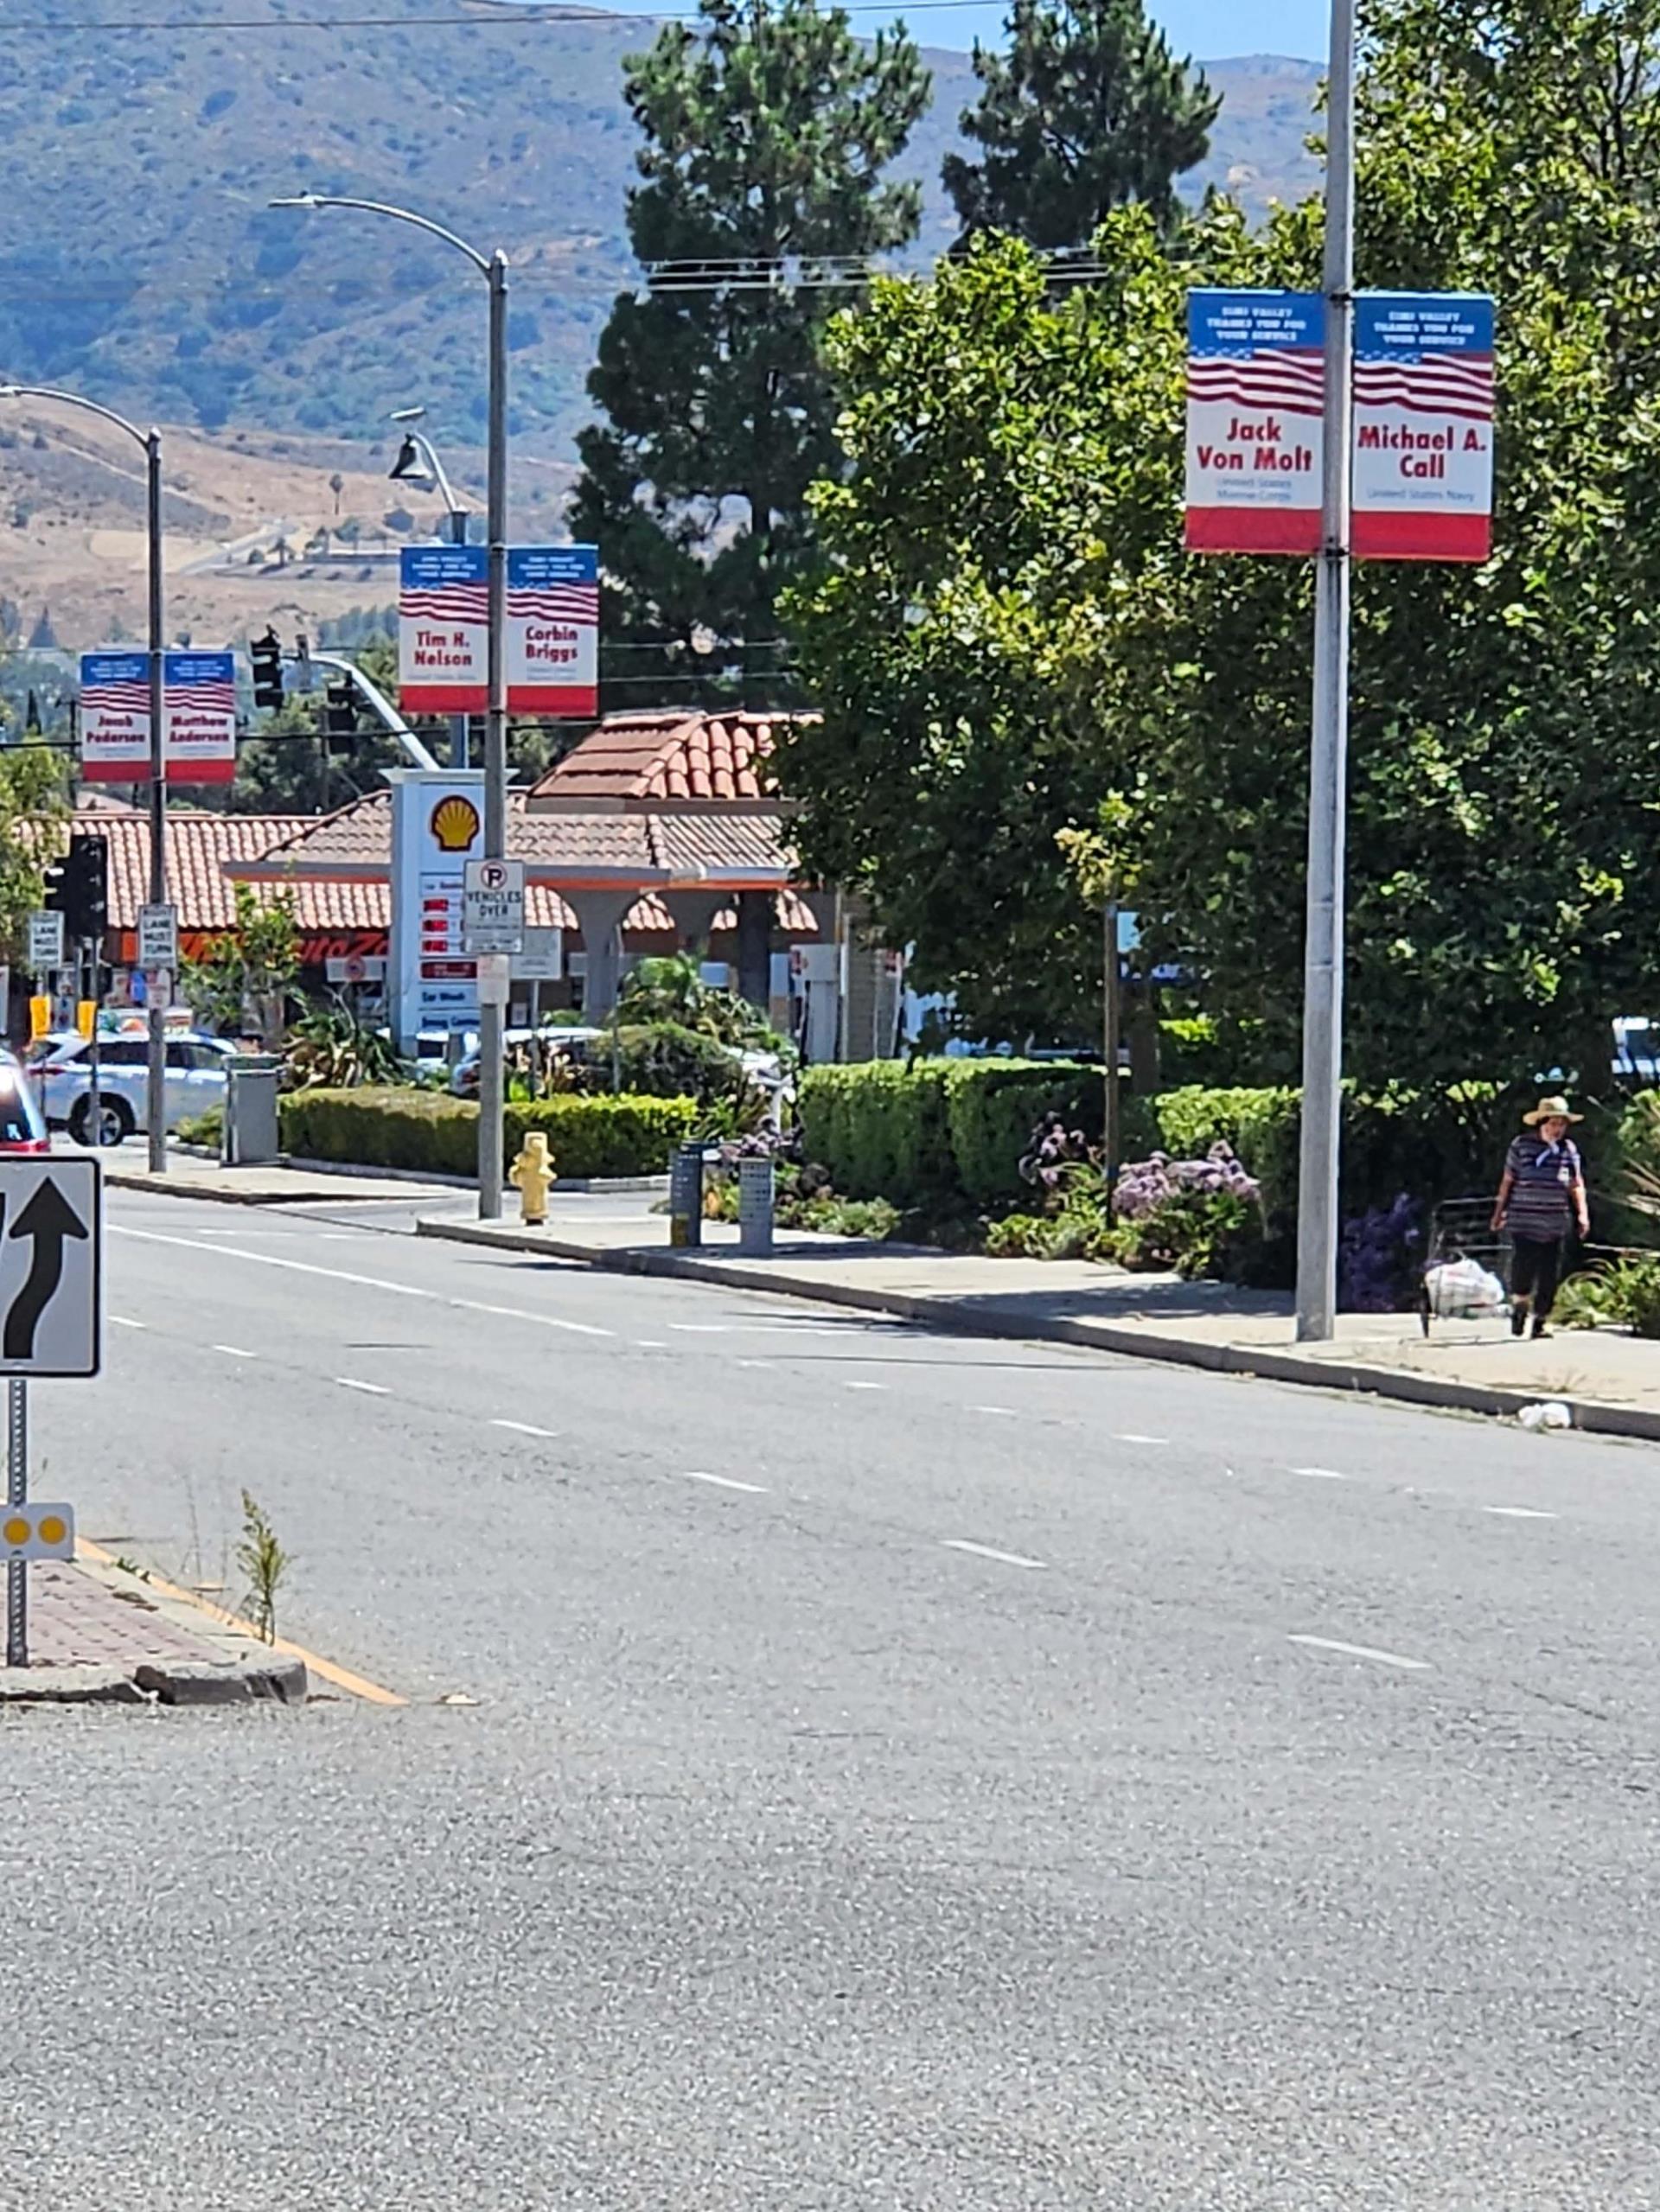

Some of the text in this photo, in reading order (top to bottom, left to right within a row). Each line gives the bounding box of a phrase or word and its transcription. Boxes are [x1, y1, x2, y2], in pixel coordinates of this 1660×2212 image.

[1226, 416, 1281, 442] Jack
[1357, 424, 1487, 451] Michael A.
[1197, 444, 1312, 472] Von Molt
[1400, 454, 1445, 479] Call
[416, 631, 447, 647] Tim
[526, 626, 578, 641] Corbin
[414, 649, 472, 666] Nelson
[526, 644, 578, 664] Briggs
[467, 890, 521, 904] VEHICLES
